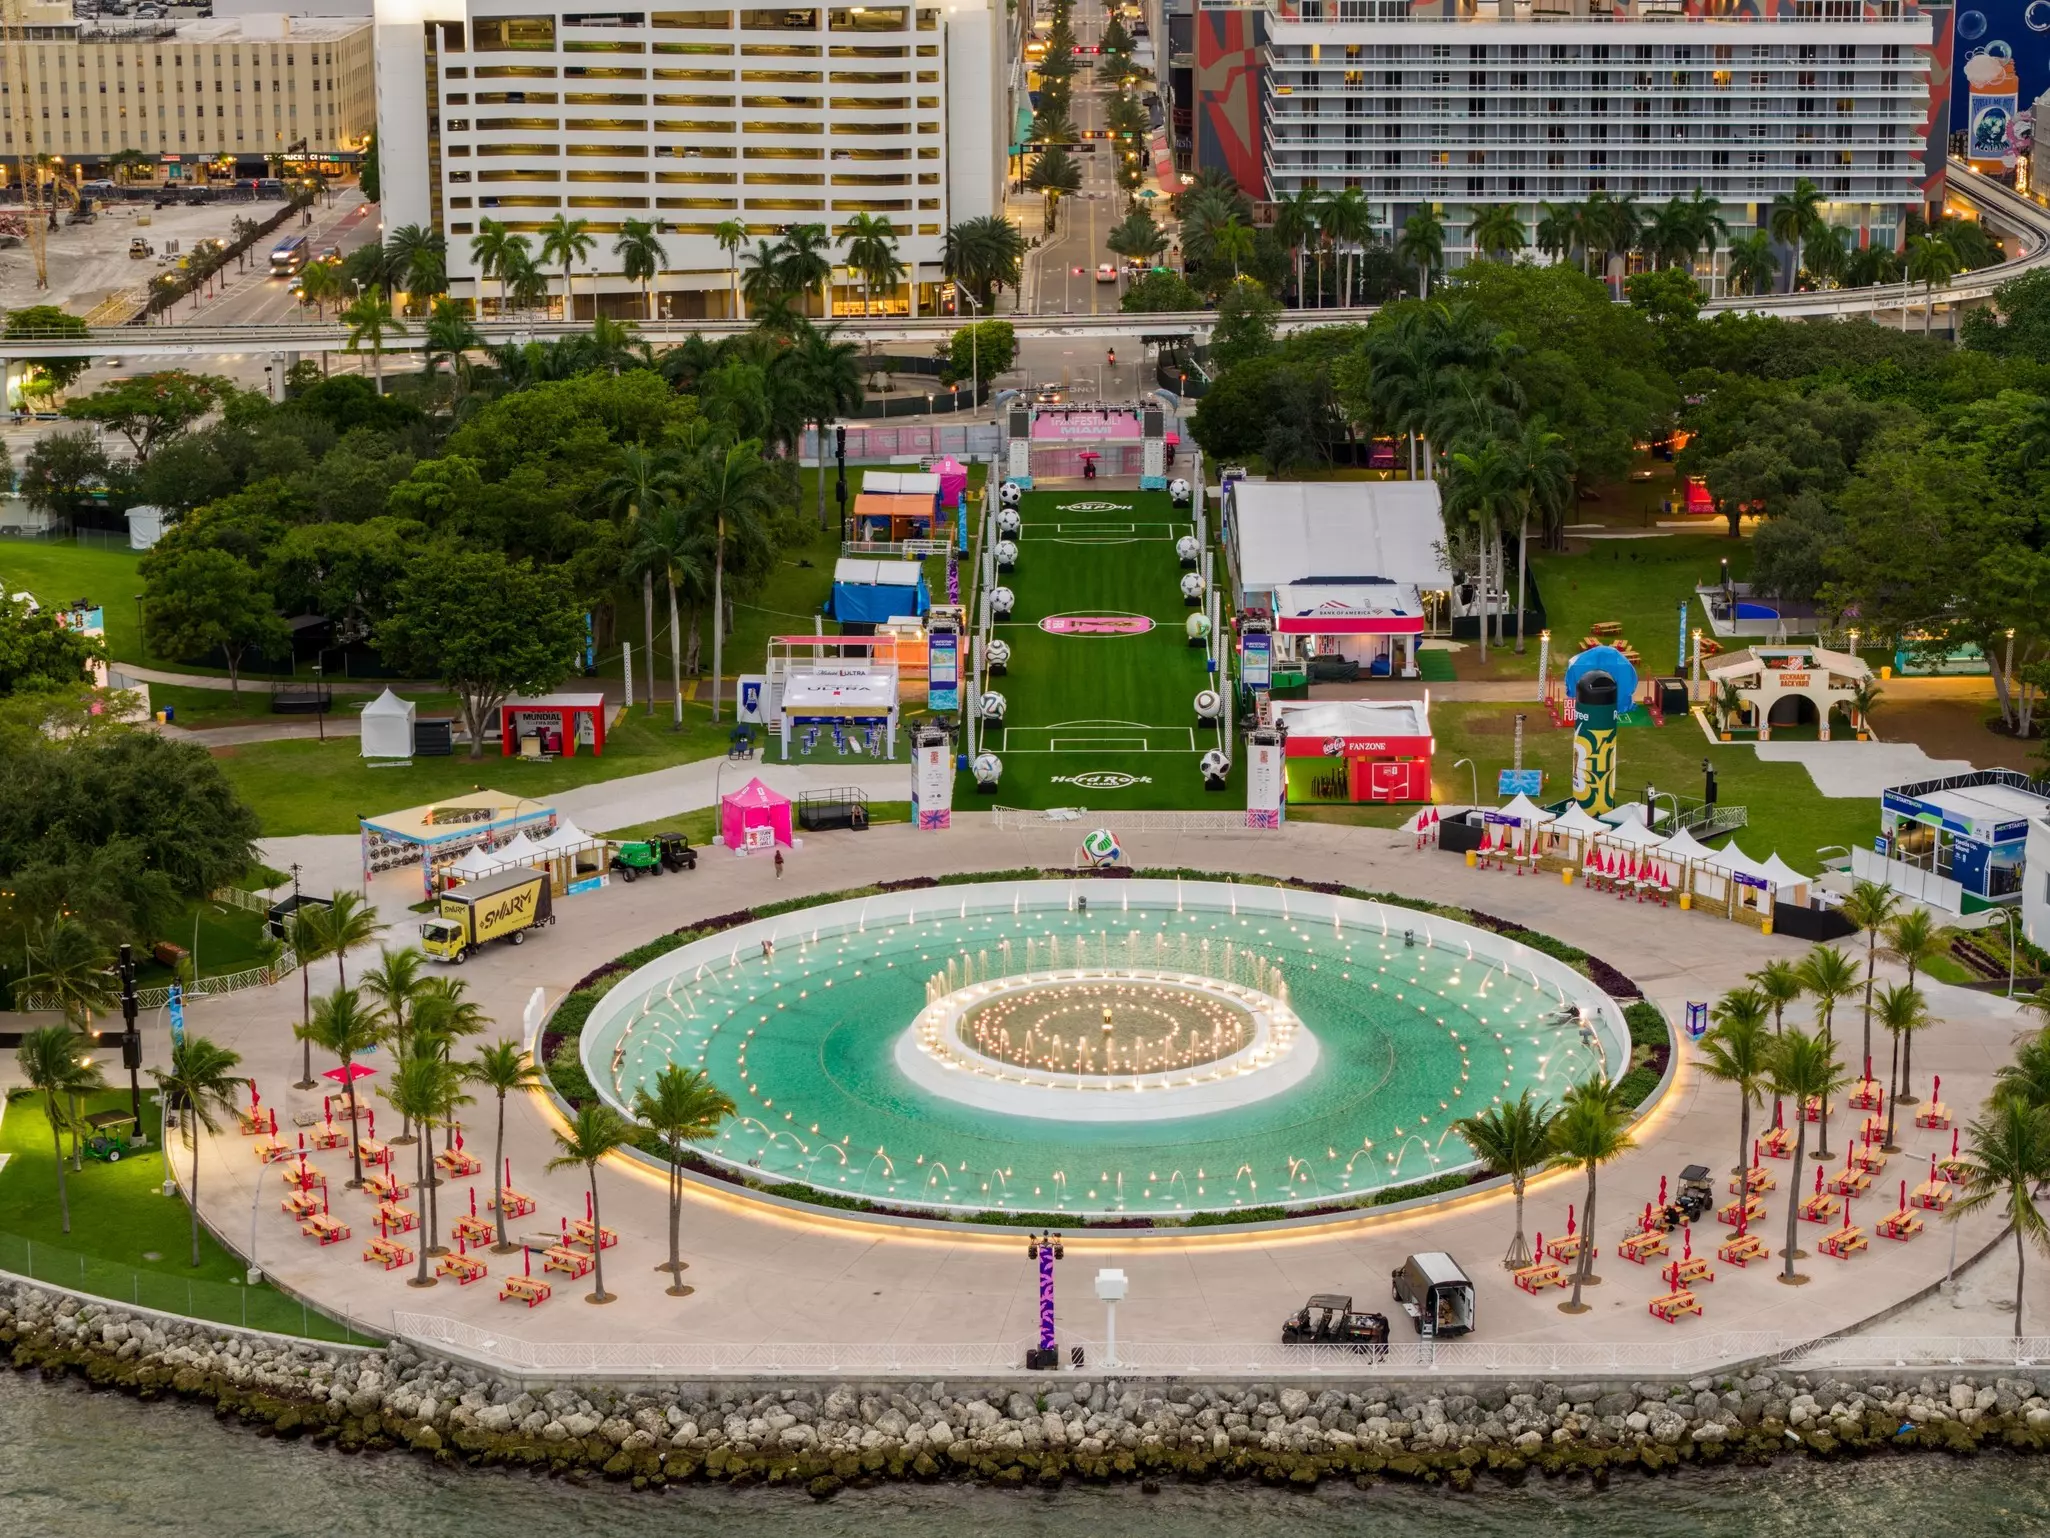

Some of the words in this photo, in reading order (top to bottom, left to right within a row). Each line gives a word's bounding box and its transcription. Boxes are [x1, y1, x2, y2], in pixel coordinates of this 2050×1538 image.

[522, 713, 562, 721] MUNDIAL
[1103, 776, 1153, 784] Rock
[444, 905, 466, 914] SWARM
[484, 888, 532, 929] SWARM
